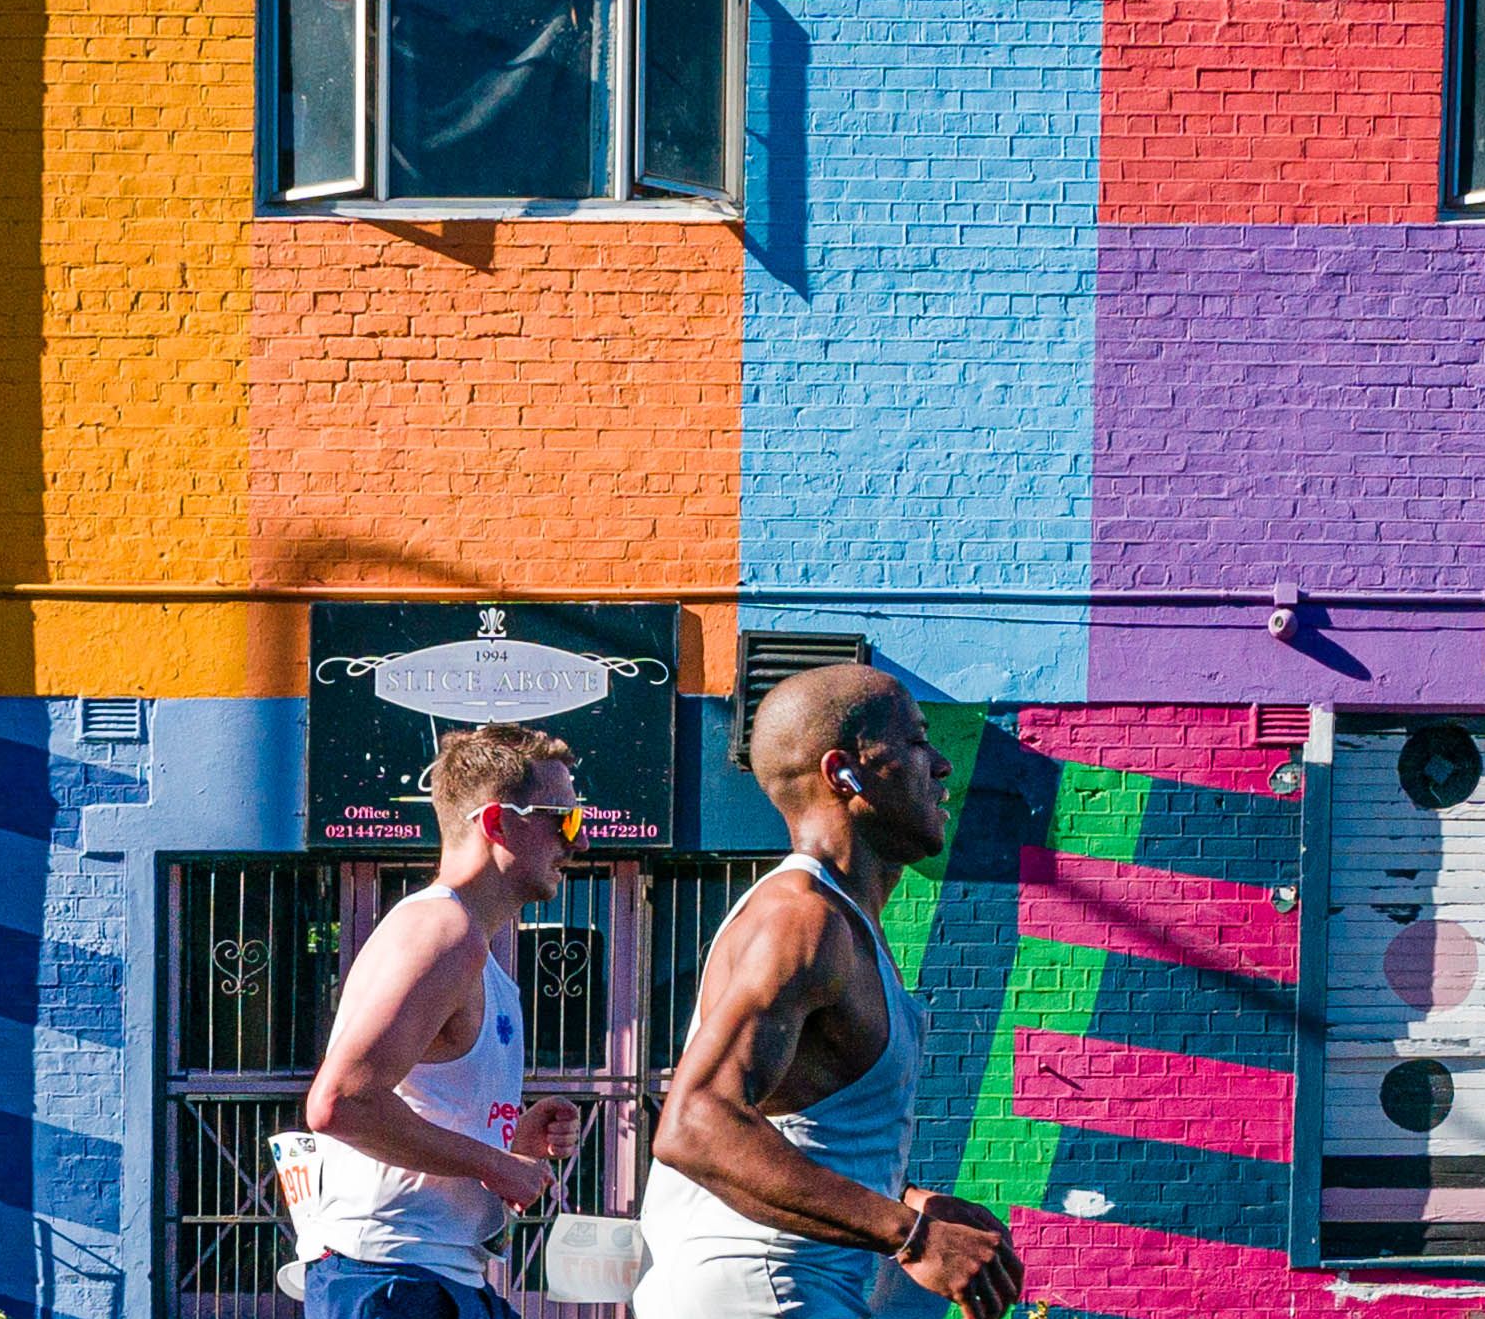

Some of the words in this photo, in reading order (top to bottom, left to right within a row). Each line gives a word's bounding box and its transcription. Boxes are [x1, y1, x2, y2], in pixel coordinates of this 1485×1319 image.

[475, 650, 508, 663] 1994
[386, 670, 481, 692] SLICE
[494, 670, 598, 692] ABOVE
[344, 806, 390, 819] Office
[582, 807, 621, 822] Shop
[325, 824, 422, 838] 0214472981
